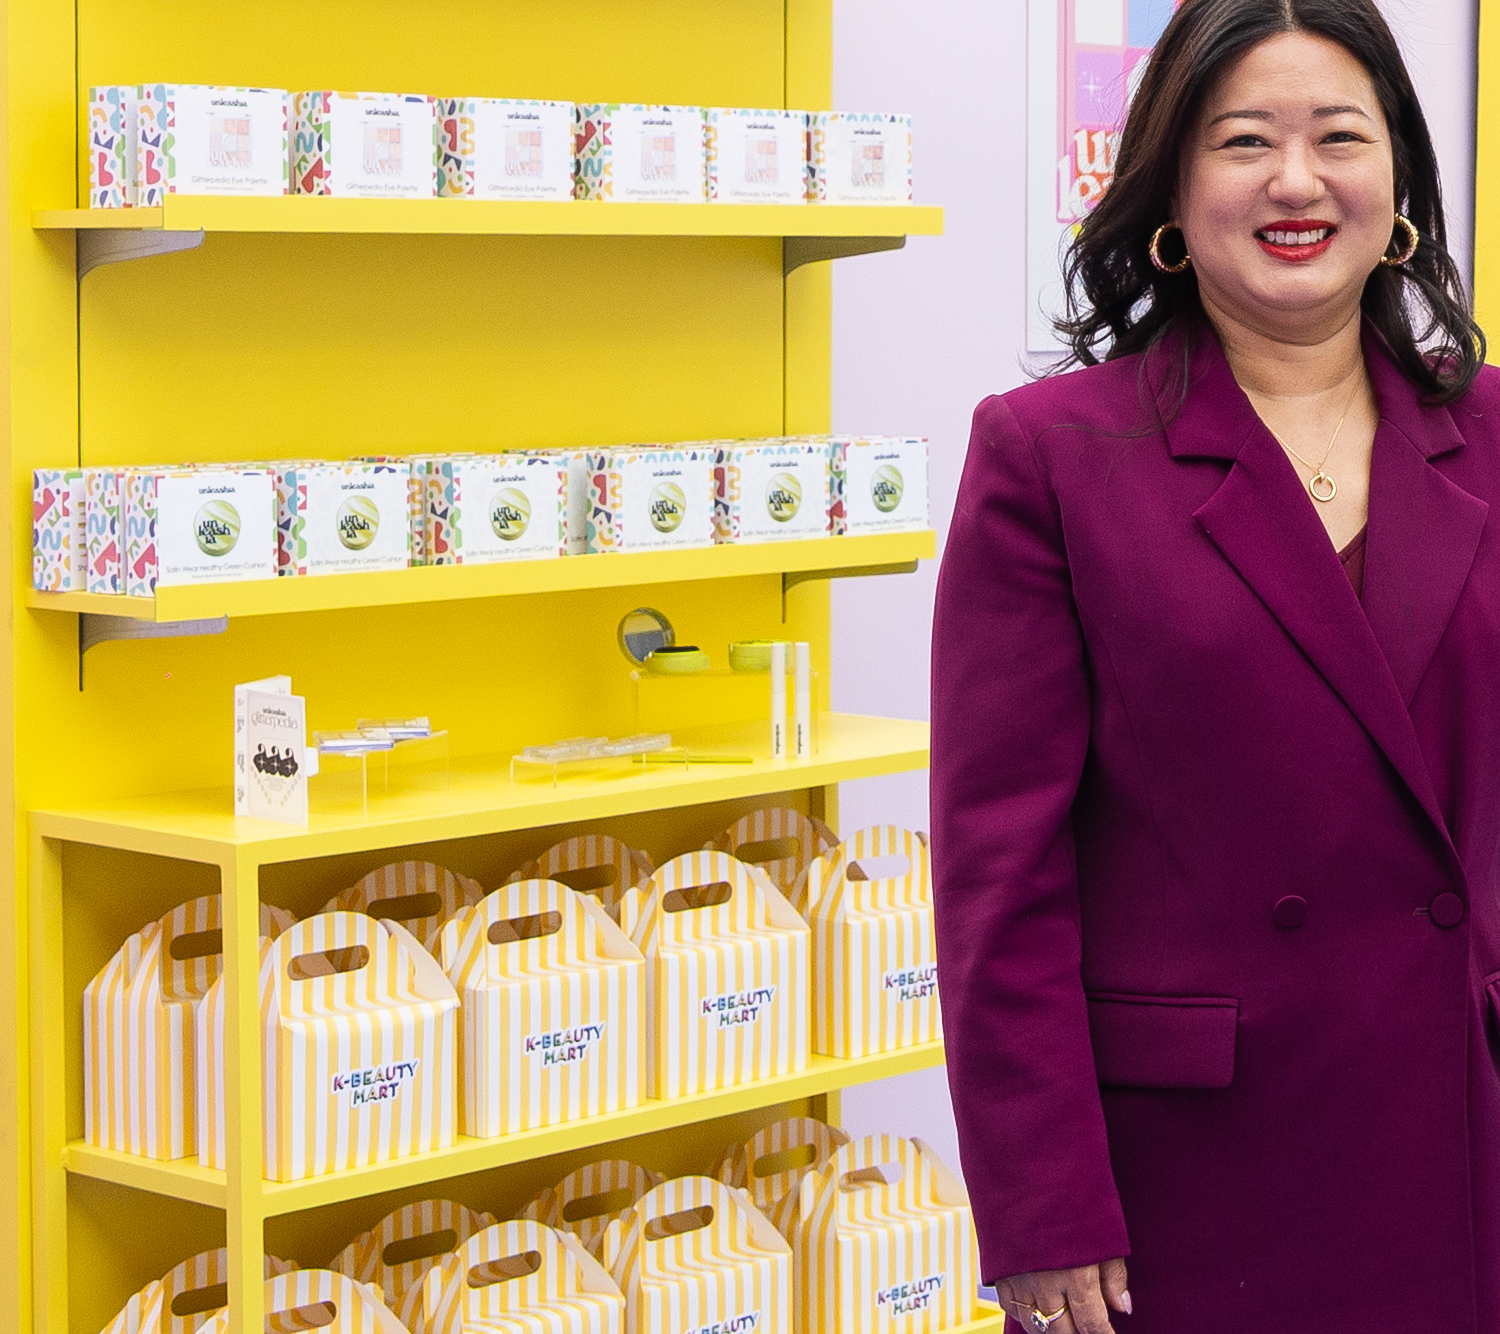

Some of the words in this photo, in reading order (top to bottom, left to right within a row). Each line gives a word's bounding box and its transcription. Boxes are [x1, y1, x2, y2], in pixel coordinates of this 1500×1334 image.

[525, 1023, 605, 1052] K-BEAUTY
[543, 1044, 587, 1065] MART
[333, 1060, 418, 1092] K-BEAUTY
[353, 1082, 399, 1105] MART
[878, 1274, 945, 1305] K-BEAUTY
[893, 1294, 929, 1315] MART
